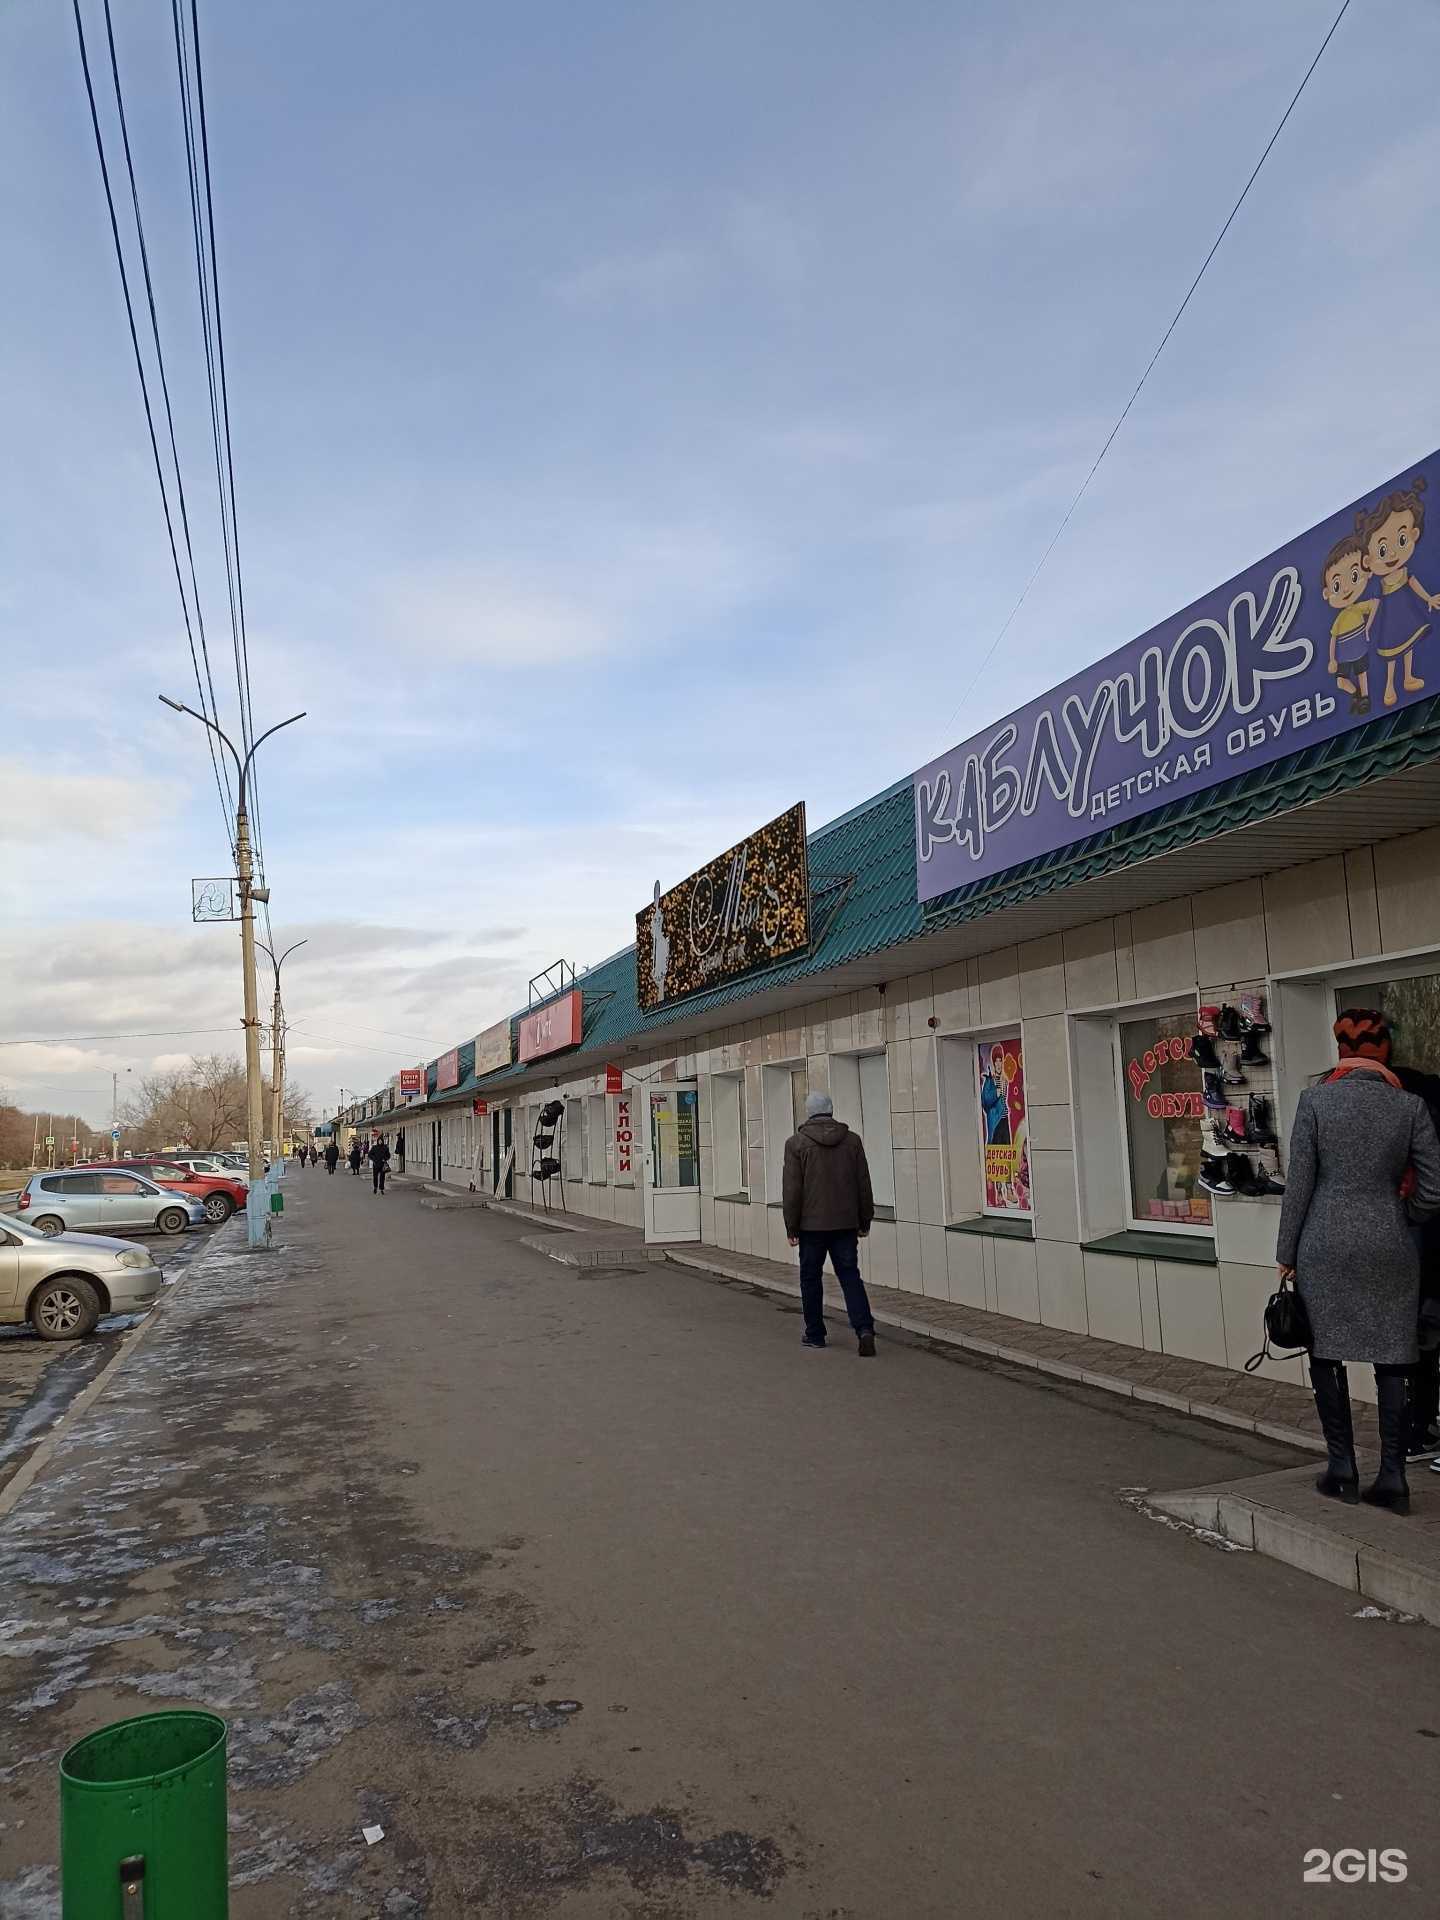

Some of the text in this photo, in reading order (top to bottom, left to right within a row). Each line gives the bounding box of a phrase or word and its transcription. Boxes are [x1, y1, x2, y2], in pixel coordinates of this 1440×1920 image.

[917, 566, 1314, 862] КАБЛУЧОК
[1089, 691, 1337, 821] ДЕТСКАЯ ОБУВЬ
[616, 1101, 633, 1172] КЛЮЧИ
